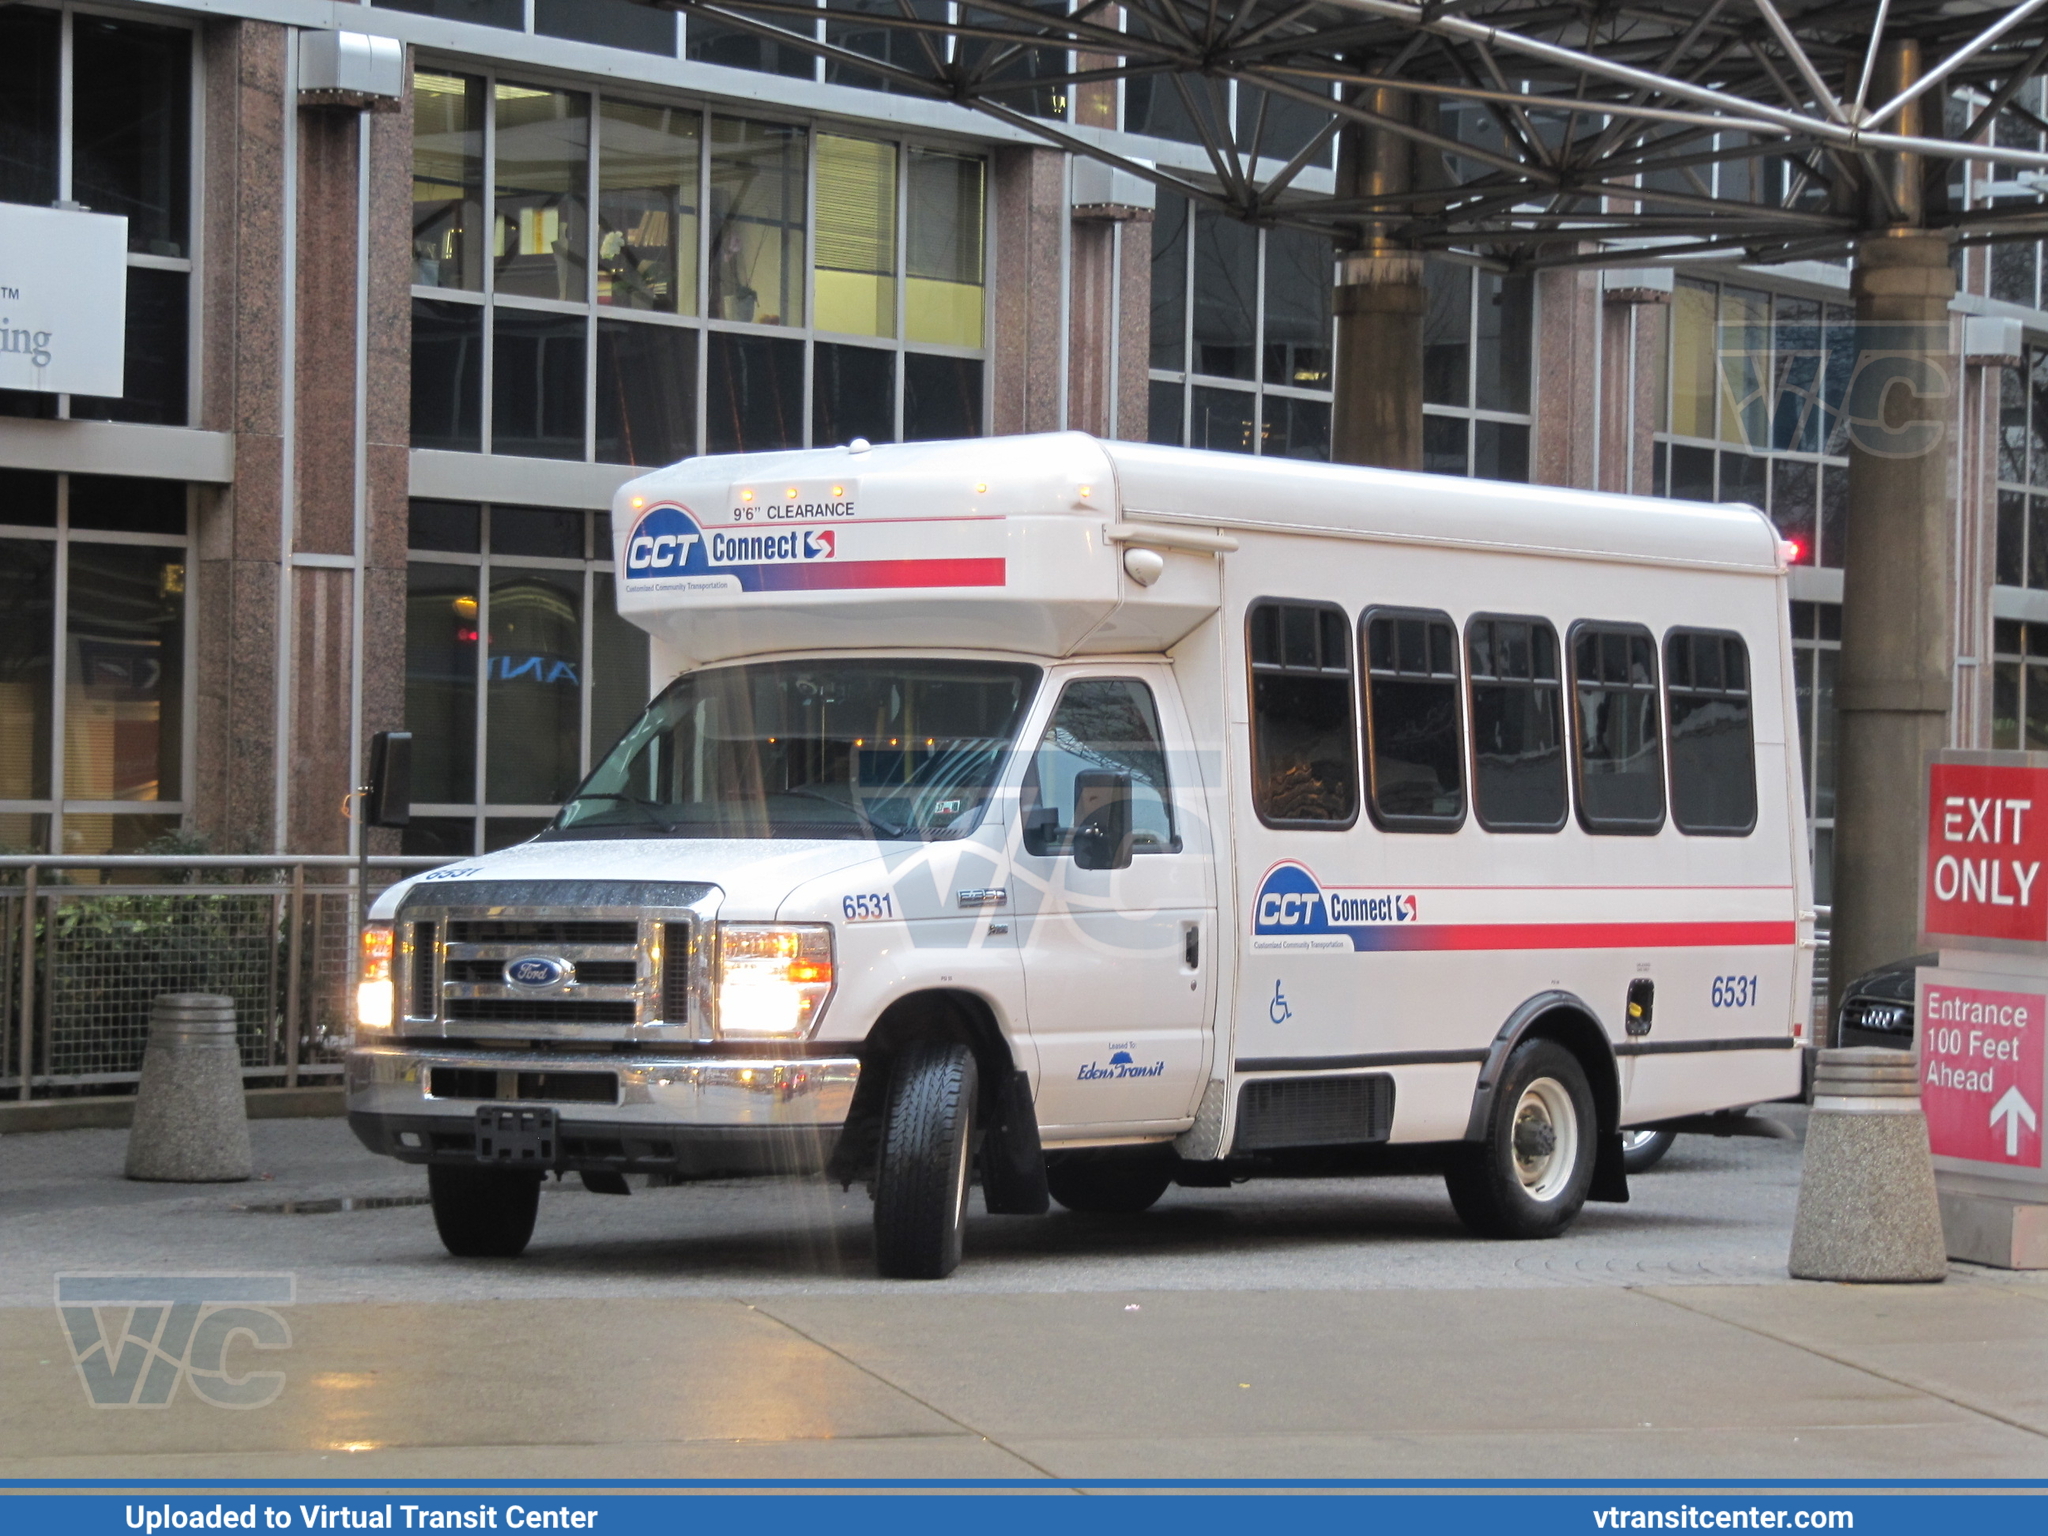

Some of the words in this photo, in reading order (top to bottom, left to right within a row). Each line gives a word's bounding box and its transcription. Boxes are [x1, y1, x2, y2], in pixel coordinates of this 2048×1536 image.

[1, 287, 19, 300] TM
[767, 502, 855, 519] CLEARANCE
[629, 534, 700, 569] CCT
[712, 531, 798, 562] Connect
[625, 583, 654, 593] Customized
[655, 582, 686, 592] Community
[687, 581, 728, 592] Transportation
[1945, 797, 2032, 845] EXIT
[1934, 854, 2041, 907] ONLY
[842, 892, 893, 921] 6531
[1258, 893, 1320, 926] CCT
[1331, 893, 1392, 922] Connect
[1253, 941, 1282, 949] Customized
[1282, 941, 1310, 950] Community
[1310, 941, 1344, 950] Transportation
[517, 963, 549, 980] Ford
[1711, 975, 1757, 1007] 6531
[1928, 992, 2028, 1028] Entrance
[1108, 1042, 1128, 1050] Leased
[1928, 1028, 1961, 1054] 100
[1969, 1030, 2019, 1061] Feet
[1077, 1061, 1114, 1080] Edens
[1114, 1061, 1165, 1078] Transit
[1926, 1060, 1993, 1092] Ahead
